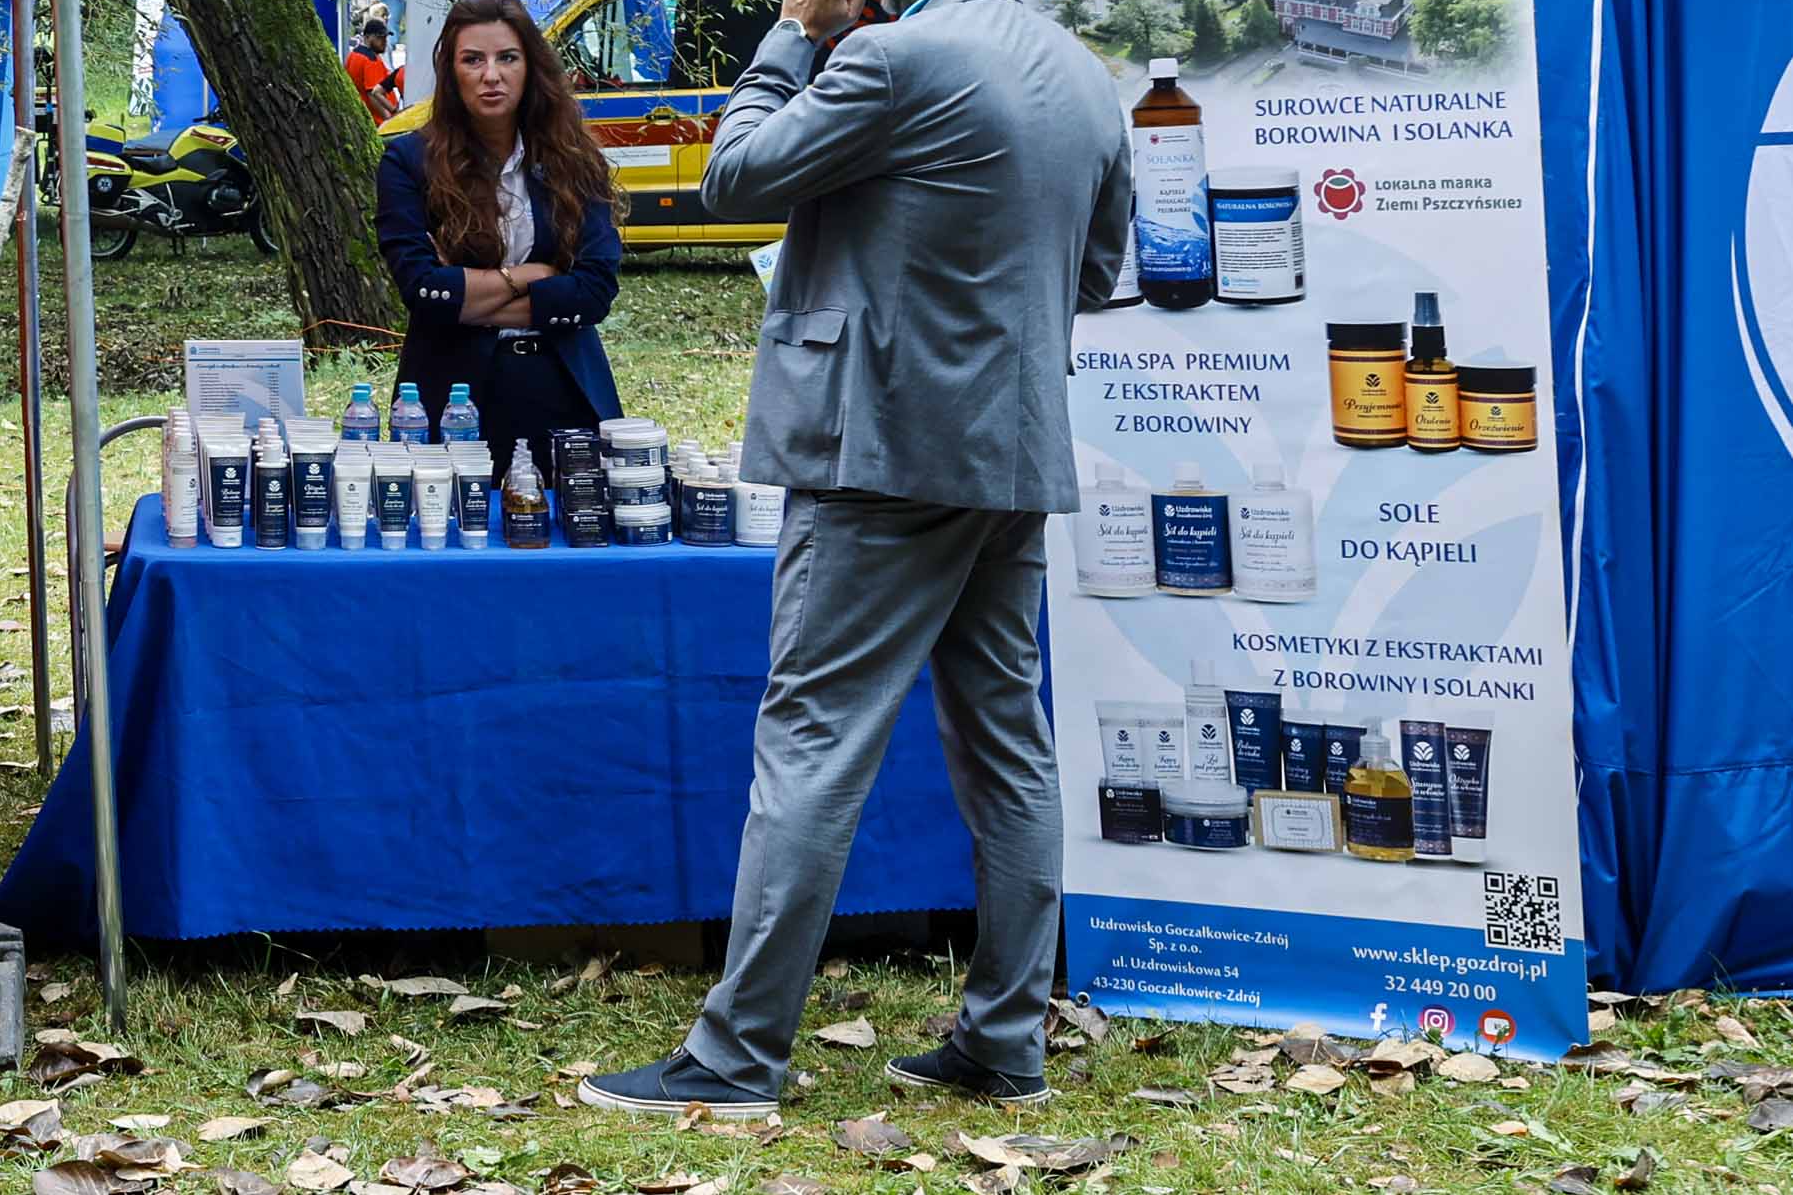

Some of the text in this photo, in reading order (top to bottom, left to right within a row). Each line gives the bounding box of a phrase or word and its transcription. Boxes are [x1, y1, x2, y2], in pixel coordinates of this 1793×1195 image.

[1255, 91, 1506, 117] SUROWCE NATURALNE
[1255, 120, 1513, 145] BOROWINA I SOLANKA
[1076, 352, 1291, 371] SERIA SPA PREMIUM
[1103, 383, 1261, 401] Z EKSTRAKTEM
[1115, 414, 1252, 434] Z BOROWINY
[1379, 502, 1440, 524] SOLE
[1341, 539, 1477, 567] DO KĄPIELI
[1232, 632, 1543, 666] KOSMETYKI Z EKSTRAKTAMI
[1273, 669, 1535, 701] Z BOROWINY I SOLANKI
[1090, 917, 1289, 949] Uzdrowisko Goczałkowice-Zdrój
[1148, 938, 1167, 953] Sp.
[1179, 943, 1202, 953] o.o.
[1112, 957, 1239, 978] ul. Uzdrowiskowa 54
[1352, 946, 1548, 982] www.sklep.gozdroj.pl
[1093, 976, 1260, 1007] 43-230 Goczałkowice-Zdrój
[1385, 975, 1496, 1001] 32 449 20 00
